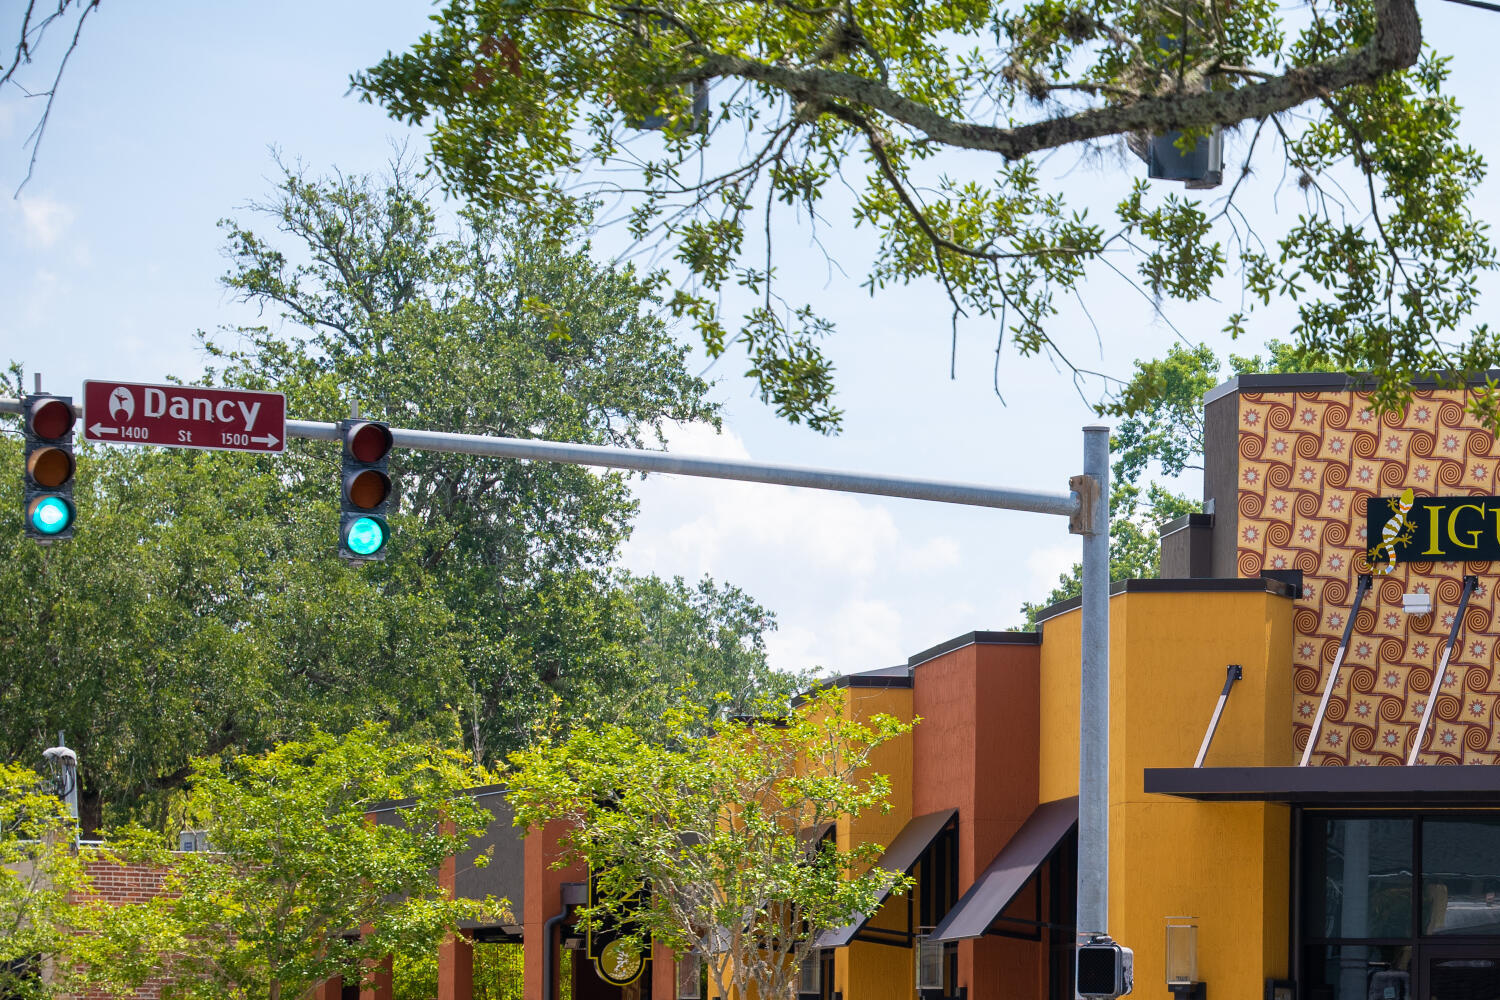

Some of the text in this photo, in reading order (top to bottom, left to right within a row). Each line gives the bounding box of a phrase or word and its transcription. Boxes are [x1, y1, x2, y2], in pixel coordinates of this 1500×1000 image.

[144, 387, 261, 432] Dancy
[120, 425, 249, 447] 1400 St 1500
